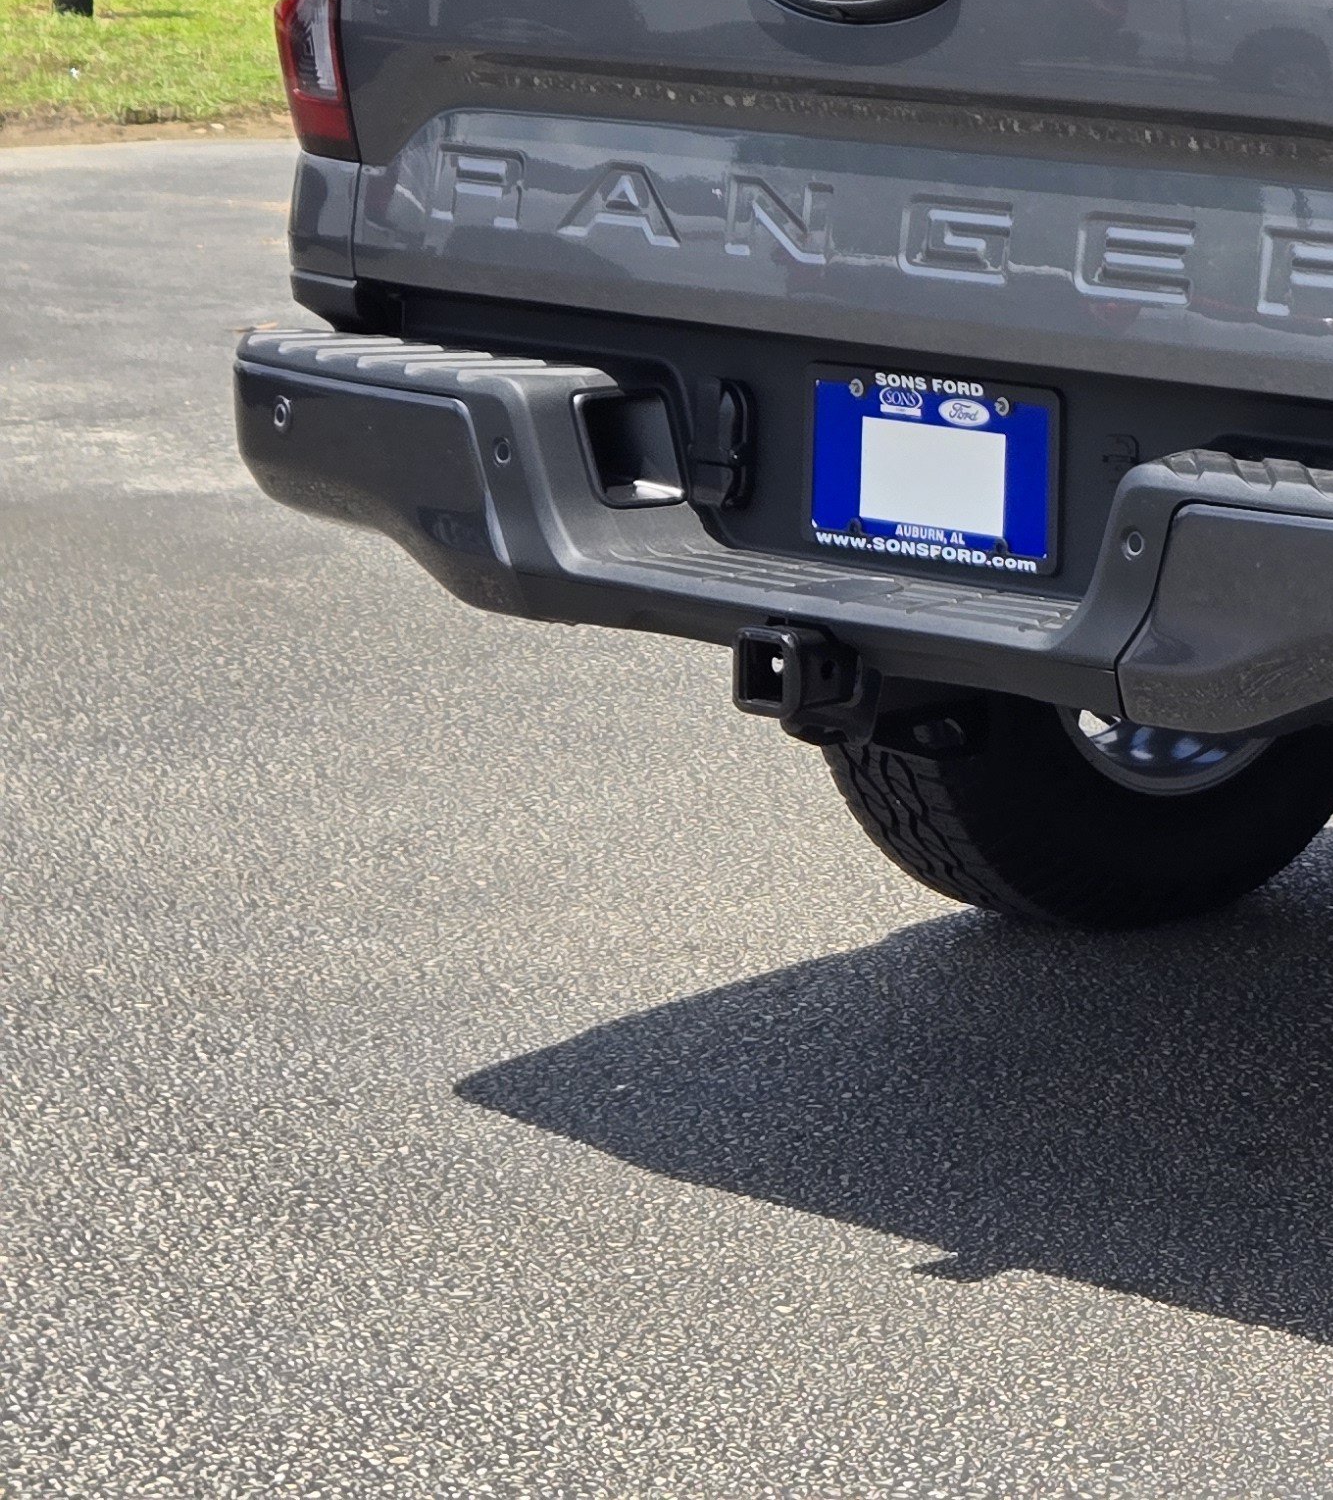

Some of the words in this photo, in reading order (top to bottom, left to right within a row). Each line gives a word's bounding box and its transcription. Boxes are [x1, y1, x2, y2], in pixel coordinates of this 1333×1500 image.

[875, 372, 927, 391] SONS
[932, 378, 984, 397] FORD
[886, 389, 917, 408] SONS
[949, 402, 980, 422] Ford
[895, 524, 948, 545] AUBURN,
[949, 533, 966, 546] AL
[816, 531, 1038, 574] www.SONSFORD.com
